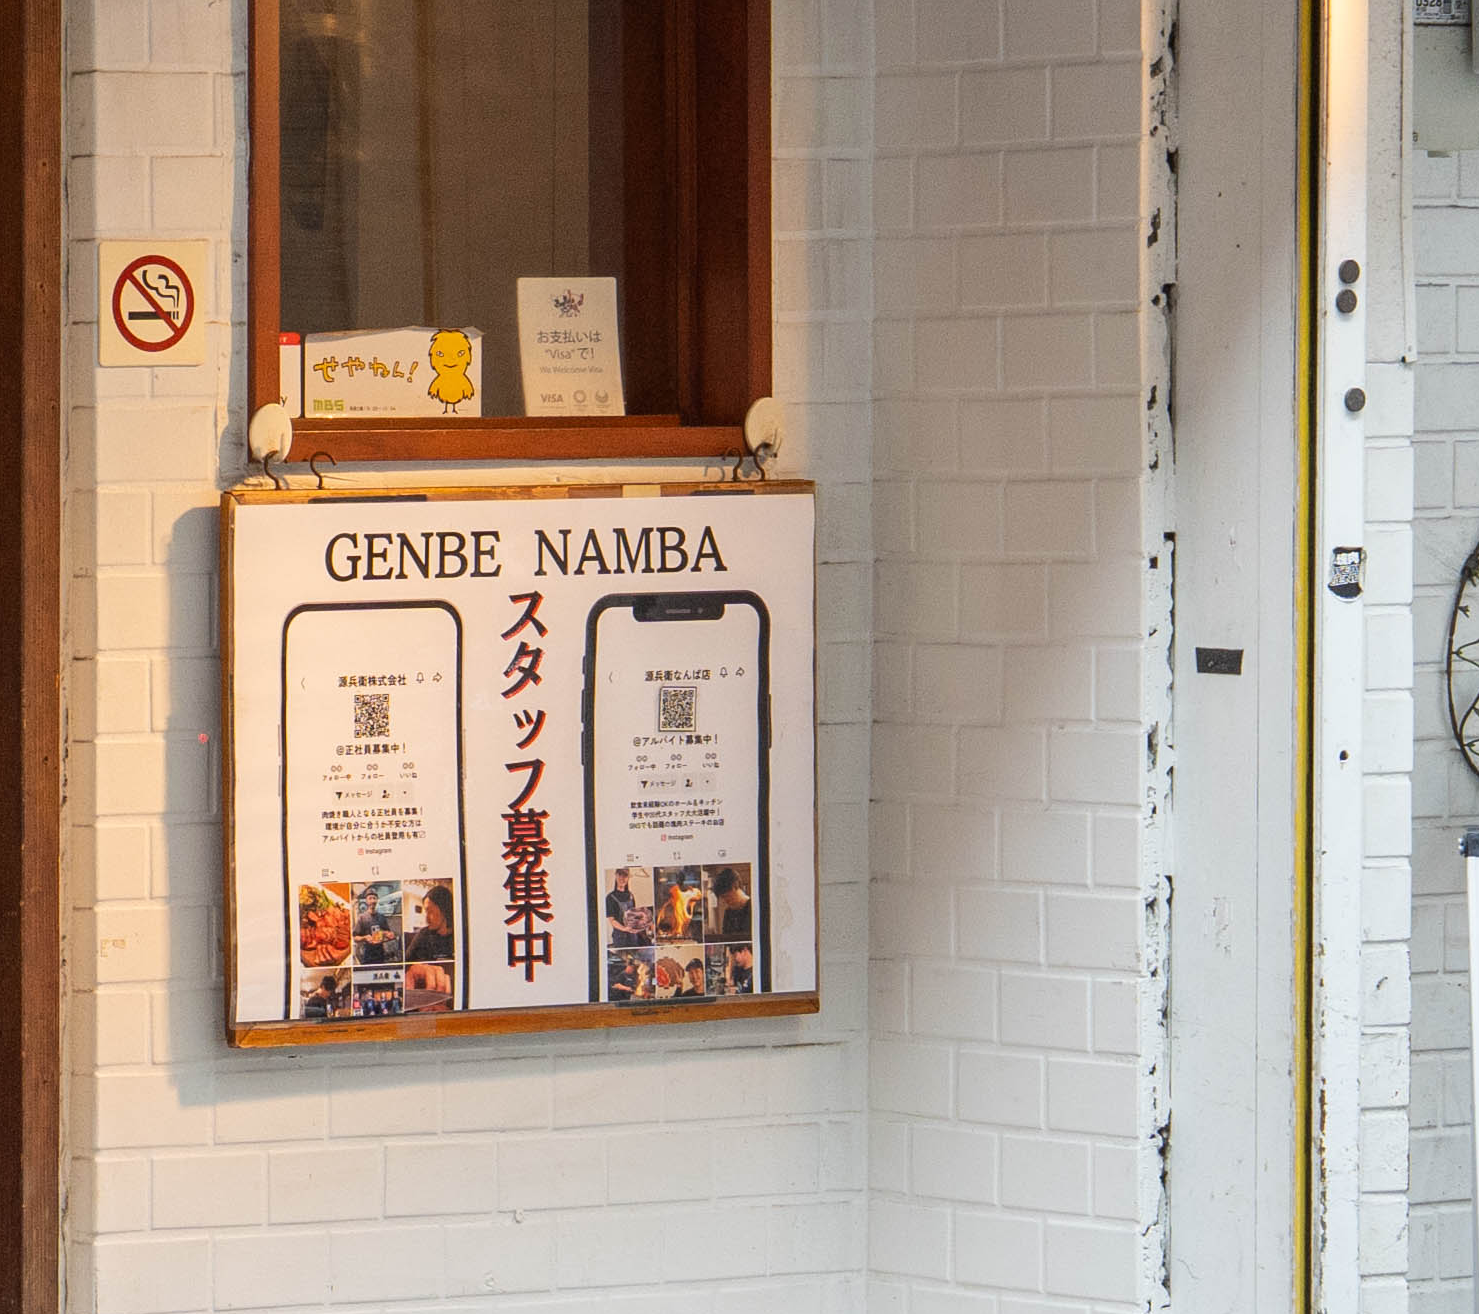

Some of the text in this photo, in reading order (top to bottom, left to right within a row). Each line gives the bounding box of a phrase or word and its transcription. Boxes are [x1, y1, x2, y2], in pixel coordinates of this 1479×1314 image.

[536, 331, 602, 344] お支払いは
[541, 393, 564, 403] VISA
[313, 399, 344, 411] MBS
[324, 525, 728, 582] GENBE NAMBA
[338, 675, 407, 687] 源兵衛株式会社
[645, 669, 711, 682] 源兵衛なんば店
[500, 590, 553, 984] スタッフ募集中
